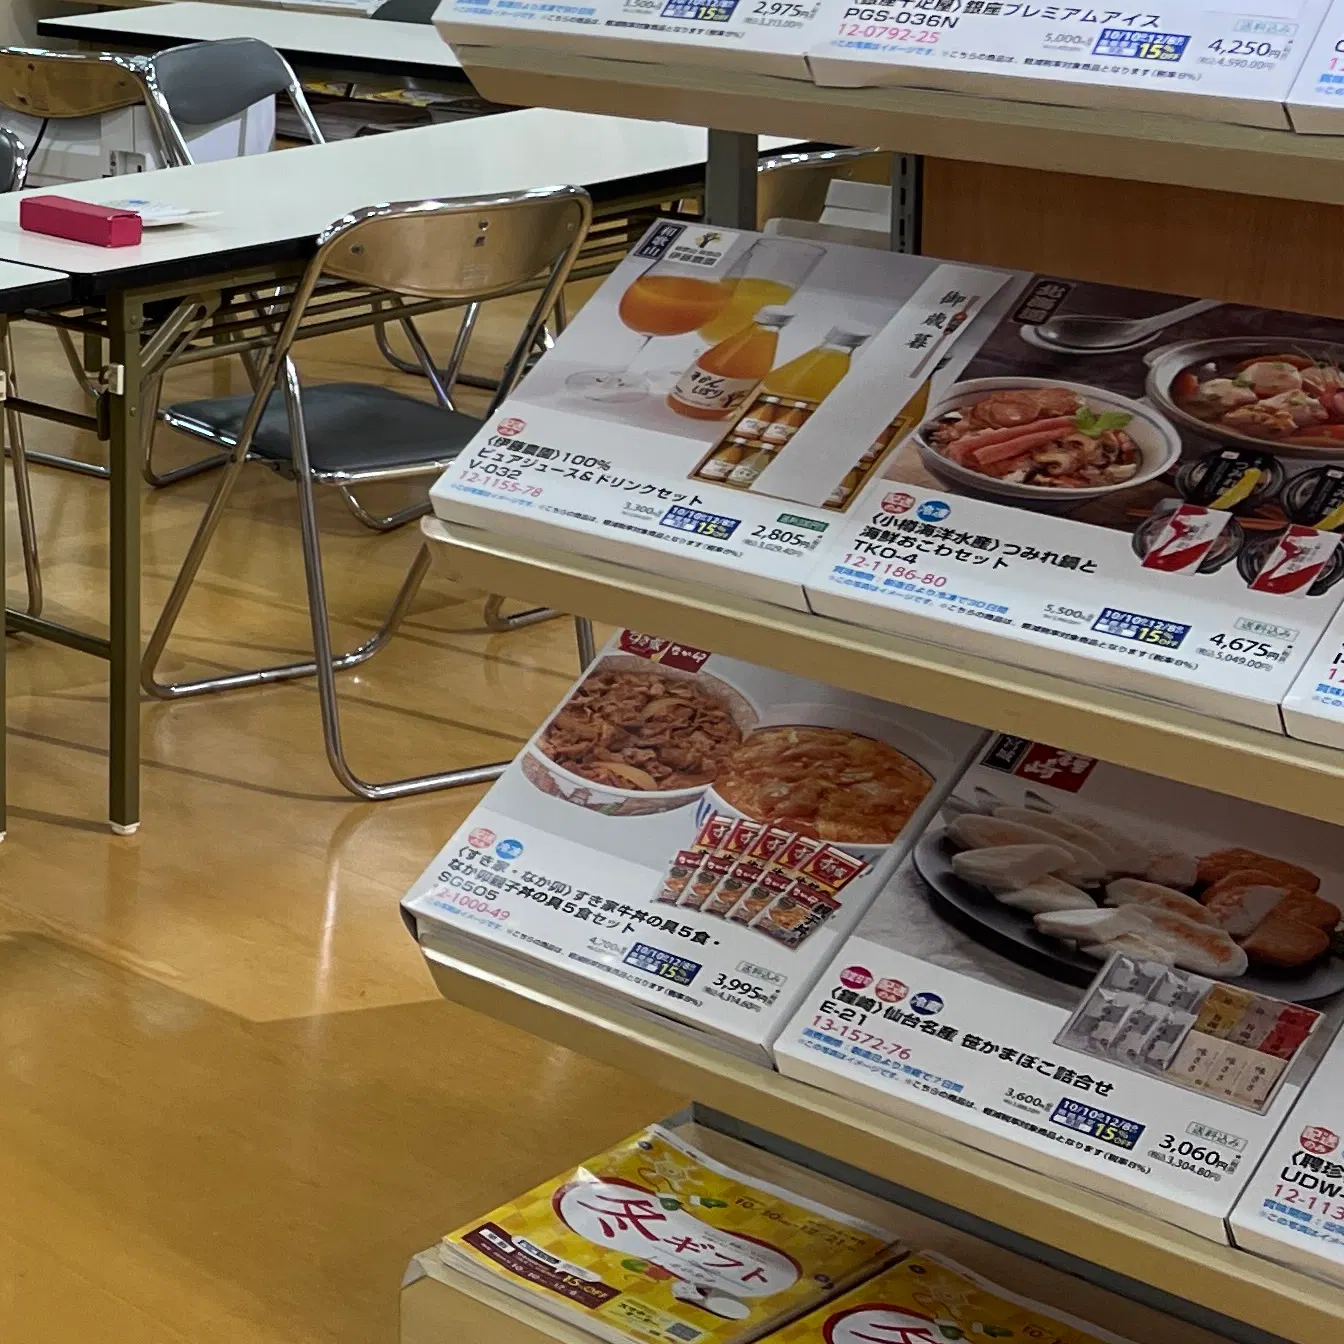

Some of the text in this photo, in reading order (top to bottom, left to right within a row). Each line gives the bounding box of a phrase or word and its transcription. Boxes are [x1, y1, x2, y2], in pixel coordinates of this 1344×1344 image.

[843, 7, 960, 30] PGS-036N
[837, 22, 940, 44] 12-0792-25
[1138, 43, 1162, 60] 15
[1207, 39, 1281, 59] 4,250円
[458, 470, 543, 498] 12-1155-78
[469, 459, 522, 481] V-032
[853, 538, 918, 564] TKO-4
[858, 524, 1010, 570] 海鮮おこわセット
[842, 552, 948, 589] 12-1186-80
[1138, 626, 1161, 644] 15
[1209, 632, 1280, 662] 4,675円
[437, 870, 500, 902] SG505
[818, 999, 867, 1027] E-21
[811, 1013, 912, 1061] 13-1572-76
[959, 1033, 1115, 1098] 笹かまぼこ詰合せ
[1094, 1121, 1117, 1142] 15
[1158, 1134, 1229, 1173] 3,060円
